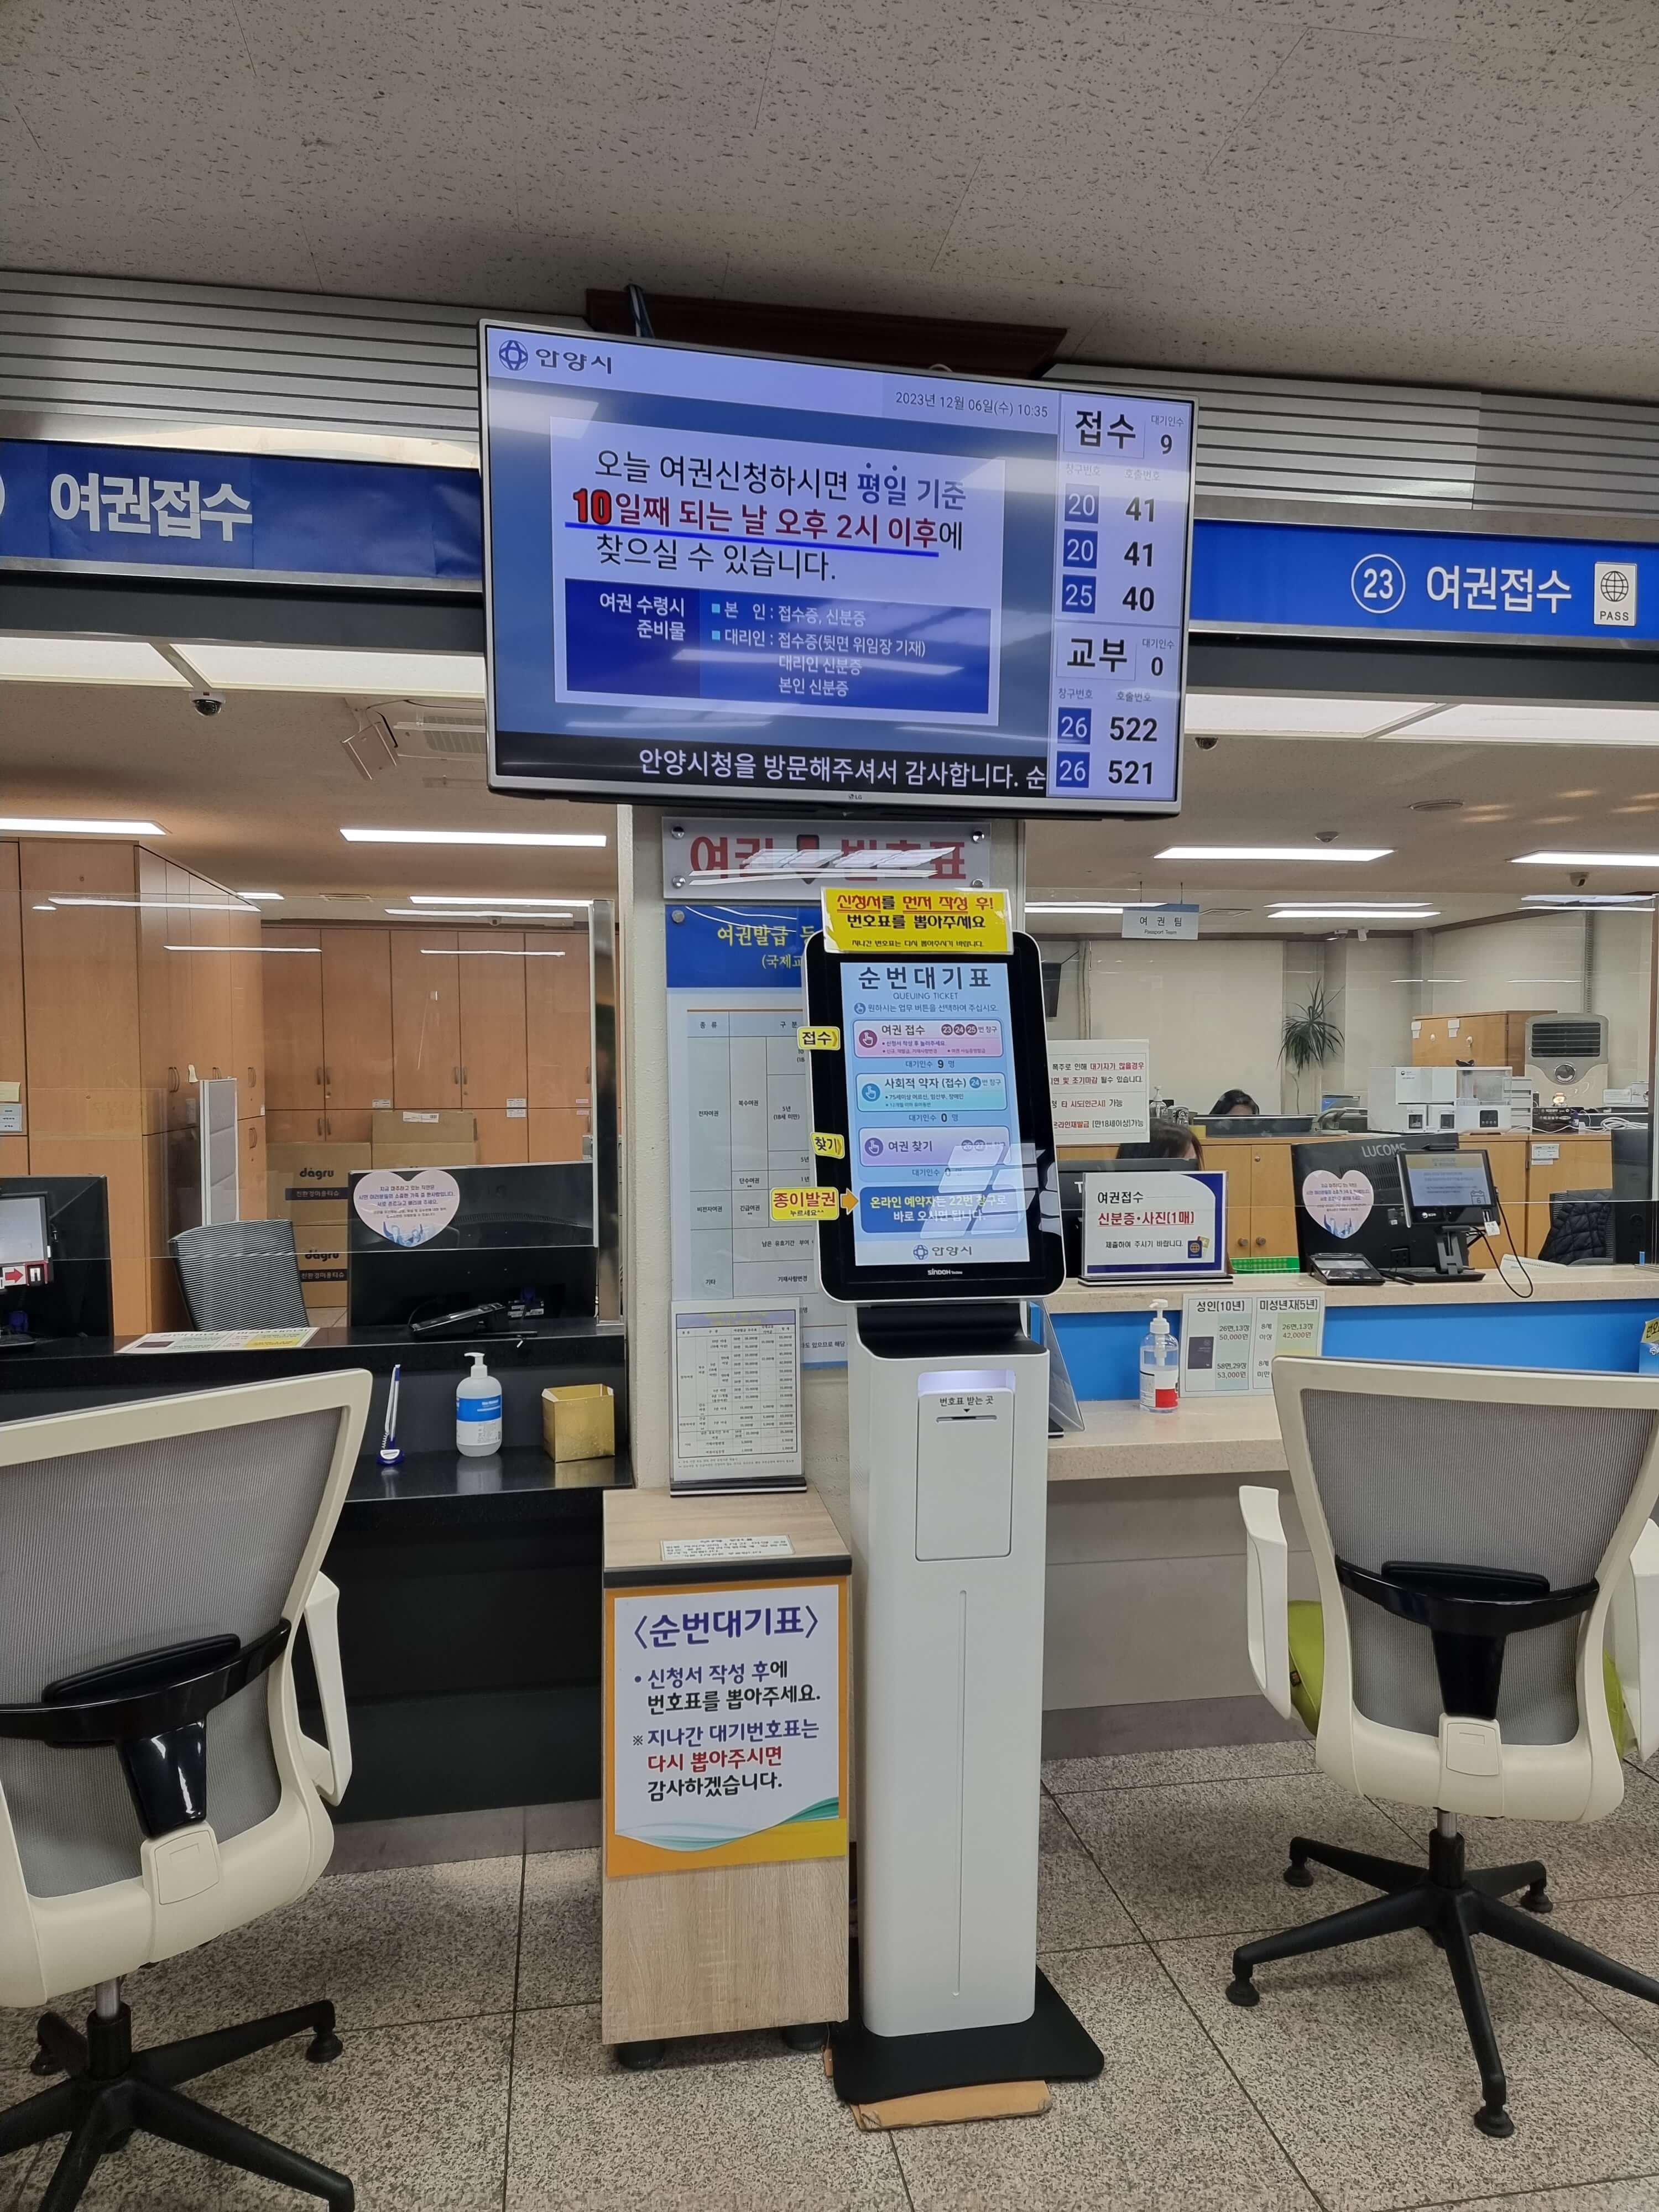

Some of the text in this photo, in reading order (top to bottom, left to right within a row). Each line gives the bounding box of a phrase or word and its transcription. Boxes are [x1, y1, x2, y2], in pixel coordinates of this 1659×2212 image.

[535, 348, 612, 374] 안양시
[896, 392, 1047, 418] 2023년 12월 06일(수) 10:35
[1075, 410, 1136, 449] 접수
[1151, 415, 1184, 427] 대기인수
[1161, 434, 1173, 455] 9
[594, 450, 966, 511] 오늘 여권신청하시면 평일 기준
[50, 472, 253, 542] 여권접수
[1068, 494, 1095, 517] 20
[1125, 498, 1155, 522] 41
[573, 488, 963, 551] 10일째 되는 날 오후 2시 이후에
[596, 533, 836, 581] 찾으실 수 있습니다.
[1067, 539, 1094, 561] 20
[1124, 542, 1153, 567] 41
[1066, 585, 1092, 606] 25
[1123, 587, 1155, 611] 40
[1363, 565, 1572, 613] 23 여권접수
[600, 592, 685, 618] 여권 수령시
[778, 605, 866, 627] 접수증, 신분증
[1600, 610, 1630, 622] PASS
[637, 619, 686, 641] 준비물
[724, 628, 925, 658] 대리인 접수증(뒷면 위임장 기재)
[1142, 638, 1175, 650] 대기인수
[779, 655, 862, 675] 대리인 신분증
[1067, 639, 1127, 673] 교부
[1151, 657, 1164, 676] 0
[778, 677, 849, 697] 본인 신분증
[1058, 687, 1093, 700] 창구번호
[1061, 716, 1088, 739] 26
[1109, 717, 1157, 742] 522
[639, 749, 757, 780] 안양시청을
[764, 755, 898, 785] 방문해주셔서
[905, 760, 1019, 790] 감사합니다.
[1060, 760, 1086, 782] 26
[1108, 761, 1153, 785] 521
[837, 895, 993, 910] 신청서를 먼저 작성 후!
[847, 915, 985, 929] 번호표를 뽑아주세요
[718, 924, 788, 947] 여권발급
[858, 967, 991, 990] 순번대기표
[868, 1004, 898, 1013] 원하시는
[899, 1004, 912, 1013] 업무
[802, 1031, 832, 1046] 접수
[882, 1025, 925, 1036] 여권 접수
[885, 1078, 966, 1089] 사회적 약자 (접수)
[941, 1114, 947, 1122] 0
[815, 1137, 837, 1151] 찾기
[889, 1141, 932, 1152] 여권 찾기
[912, 1168, 940, 1177] 대기인수
[773, 1192, 836, 1208] 종이발권
[870, 1197, 901, 1208] 온라인
[1098, 1192, 1144, 1204] 여권접수
[894, 1212, 914, 1223] 바로
[932, 1246, 972, 1256] 안양시
[1197, 1301, 1245, 1312] 성인(10년)
[1260, 1300, 1317, 1311] 미성년자(5년)
[940, 1396, 993, 1406] 번호표 받는 곳
[648, 1660, 787, 1690] 신청서 작성 후에
[648, 1684, 820, 1715] 번호표를 뽑아주세요.
[648, 1719, 820, 1747] 지나간 대기번호표는
[648, 1745, 781, 1773] 다시 뽑아주시면
[648, 1772, 782, 1802] 감사하겠습니다.
